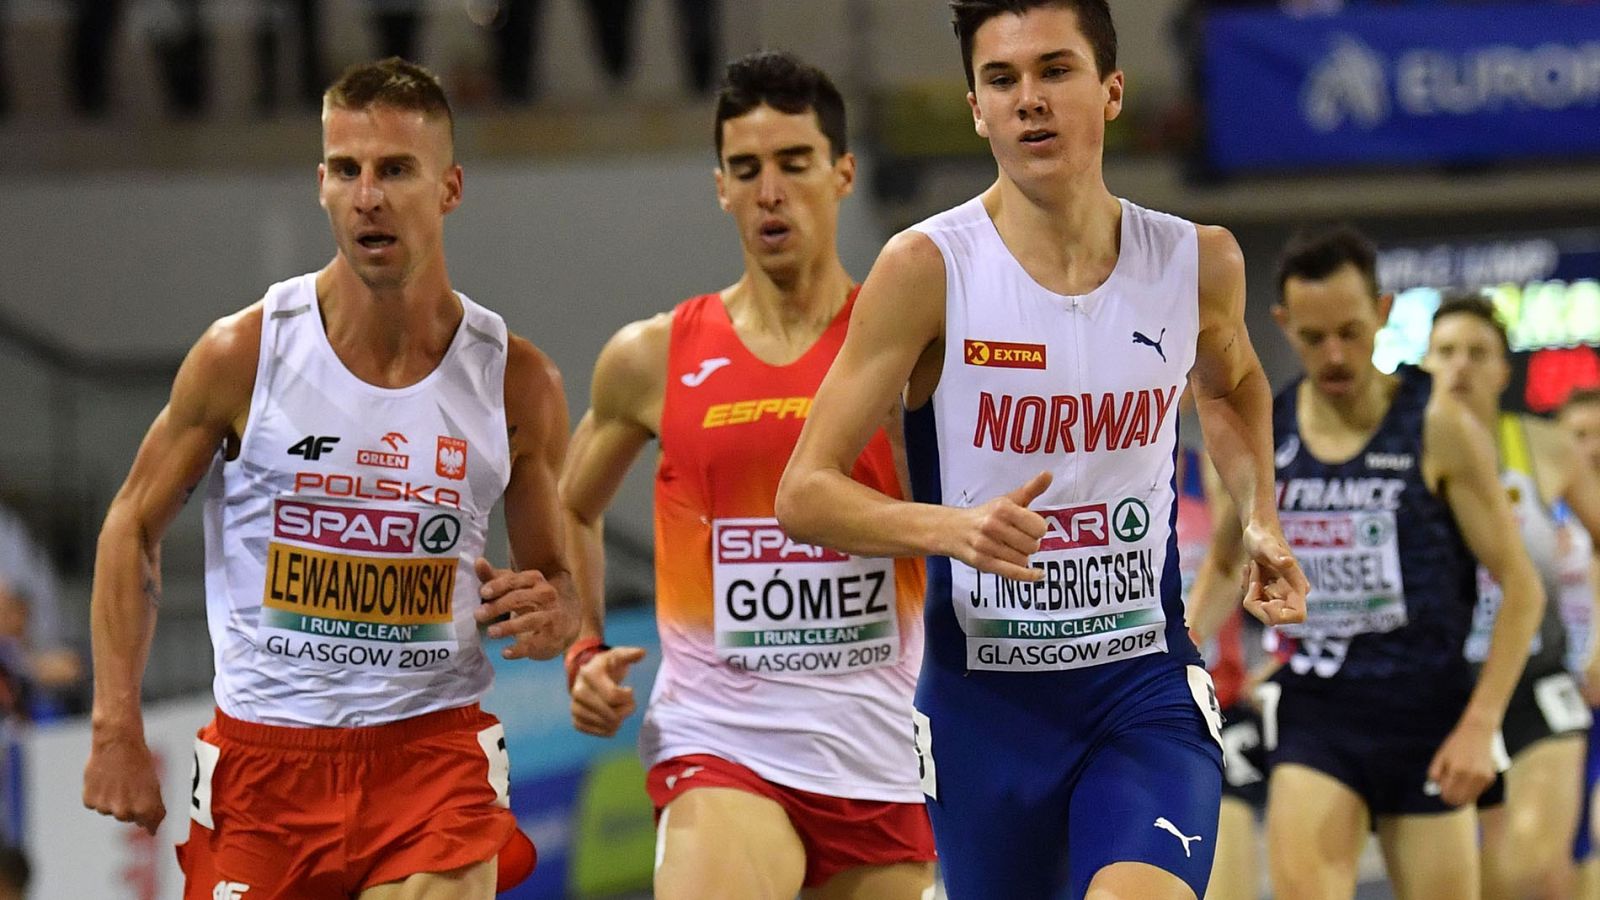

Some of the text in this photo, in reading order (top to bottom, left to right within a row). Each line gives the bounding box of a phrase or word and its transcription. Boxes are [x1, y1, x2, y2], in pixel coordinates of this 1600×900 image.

[993, 349, 1042, 363] EXTRA
[703, 397, 814, 428] ESPA
[973, 386, 1177, 454] NORWAY
[287, 435, 341, 461] 4F
[359, 450, 407, 468] ORLEN
[294, 472, 461, 510] POLSKA
[1282, 478, 1405, 511] FRANCE
[278, 504, 412, 547] SPAR
[1044, 511, 1105, 544] AR
[720, 528, 846, 559] SPA
[269, 550, 454, 616] LEWANDOWSKI
[970, 549, 1155, 611] J. INGEBRIGTSEN
[1300, 553, 1392, 591] NISSEL
[726, 569, 888, 621] GÓMEZ
[301, 616, 306, 630] I
[311, 617, 350, 636] RUN
[754, 632, 760, 645] I
[763, 630, 800, 645] RUN
[1008, 622, 1012, 636] I
[1018, 621, 1056, 636] RUN
[266, 635, 393, 668] GLASGOW
[726, 643, 891, 673] GLASGOW 2019
[977, 630, 1156, 665] GLASGOW 2019
